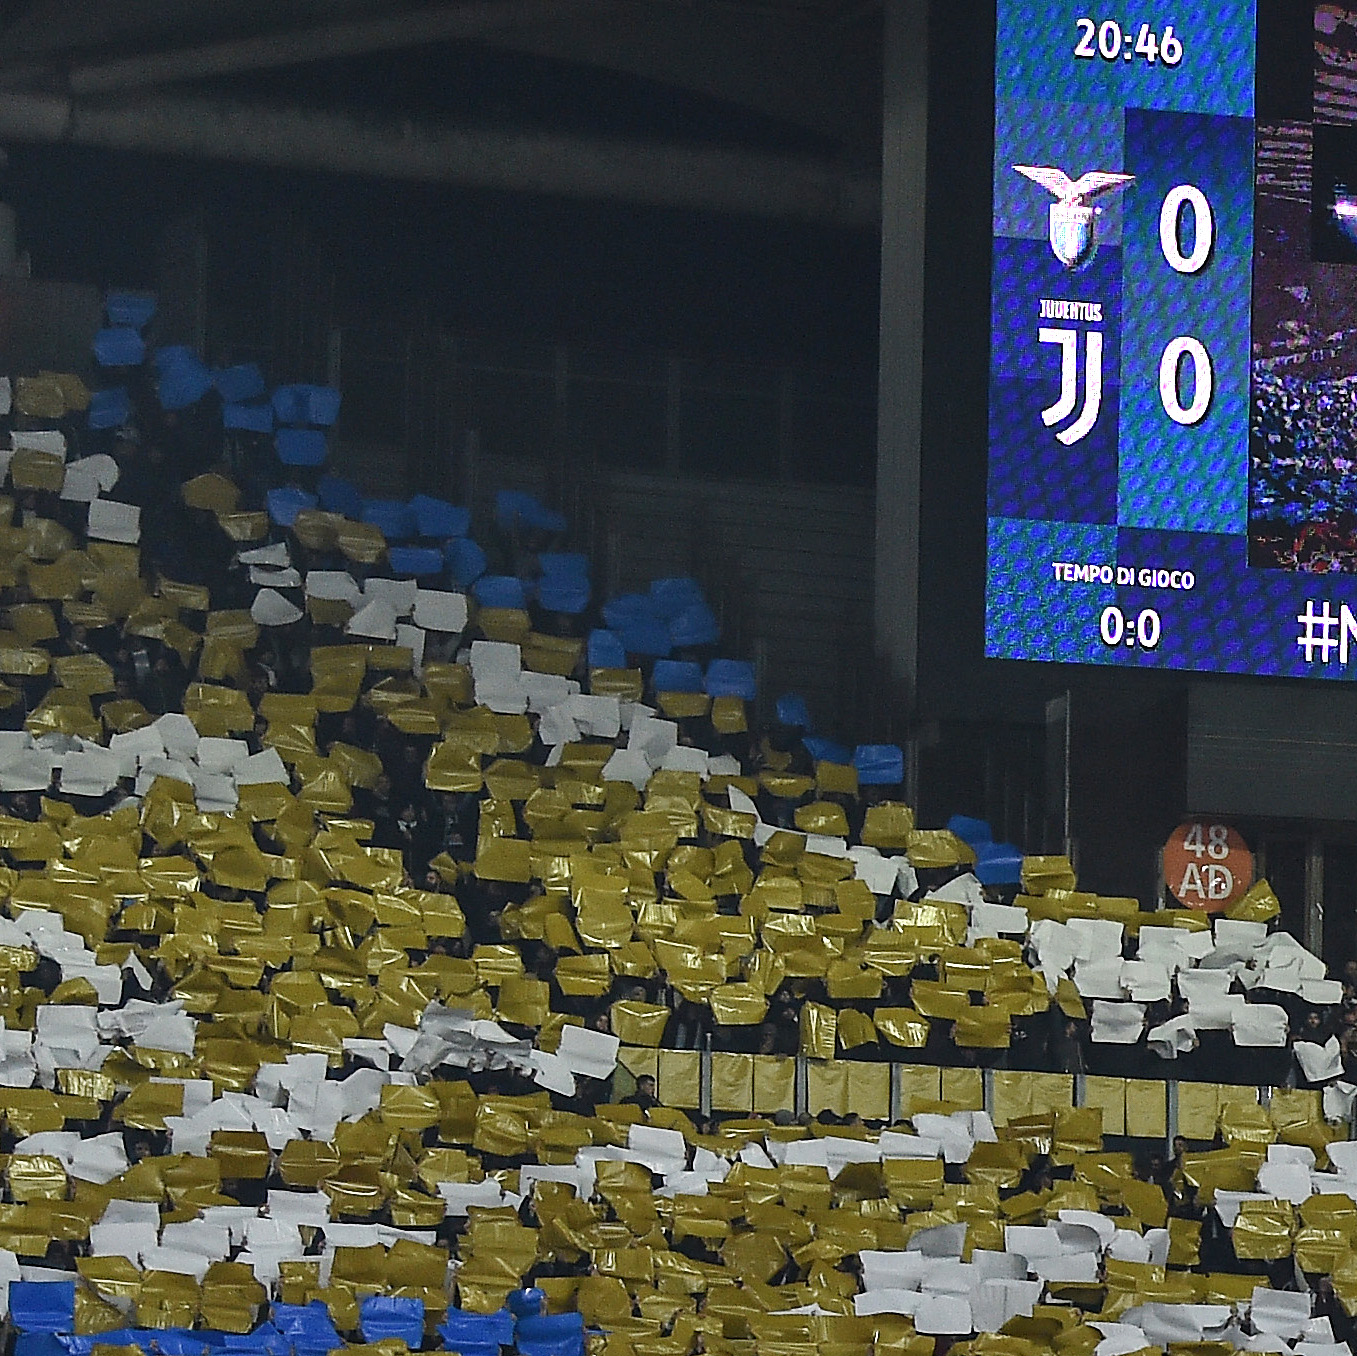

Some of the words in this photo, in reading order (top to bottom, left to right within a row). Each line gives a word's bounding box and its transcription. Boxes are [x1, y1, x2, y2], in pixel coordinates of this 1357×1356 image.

[1075, 18, 1184, 65] 20:46
[1158, 184, 1214, 274] 0
[1039, 299, 1104, 322] JUVENTUS
[1158, 335, 1214, 426] 0
[1051, 561, 1114, 585] TEMPO
[1116, 566, 1135, 586] DI
[1138, 568, 1195, 590] GIOCO
[1100, 606, 1161, 649] 0:0
[1183, 822, 1230, 860] 48
[1178, 862, 1234, 899] AD
